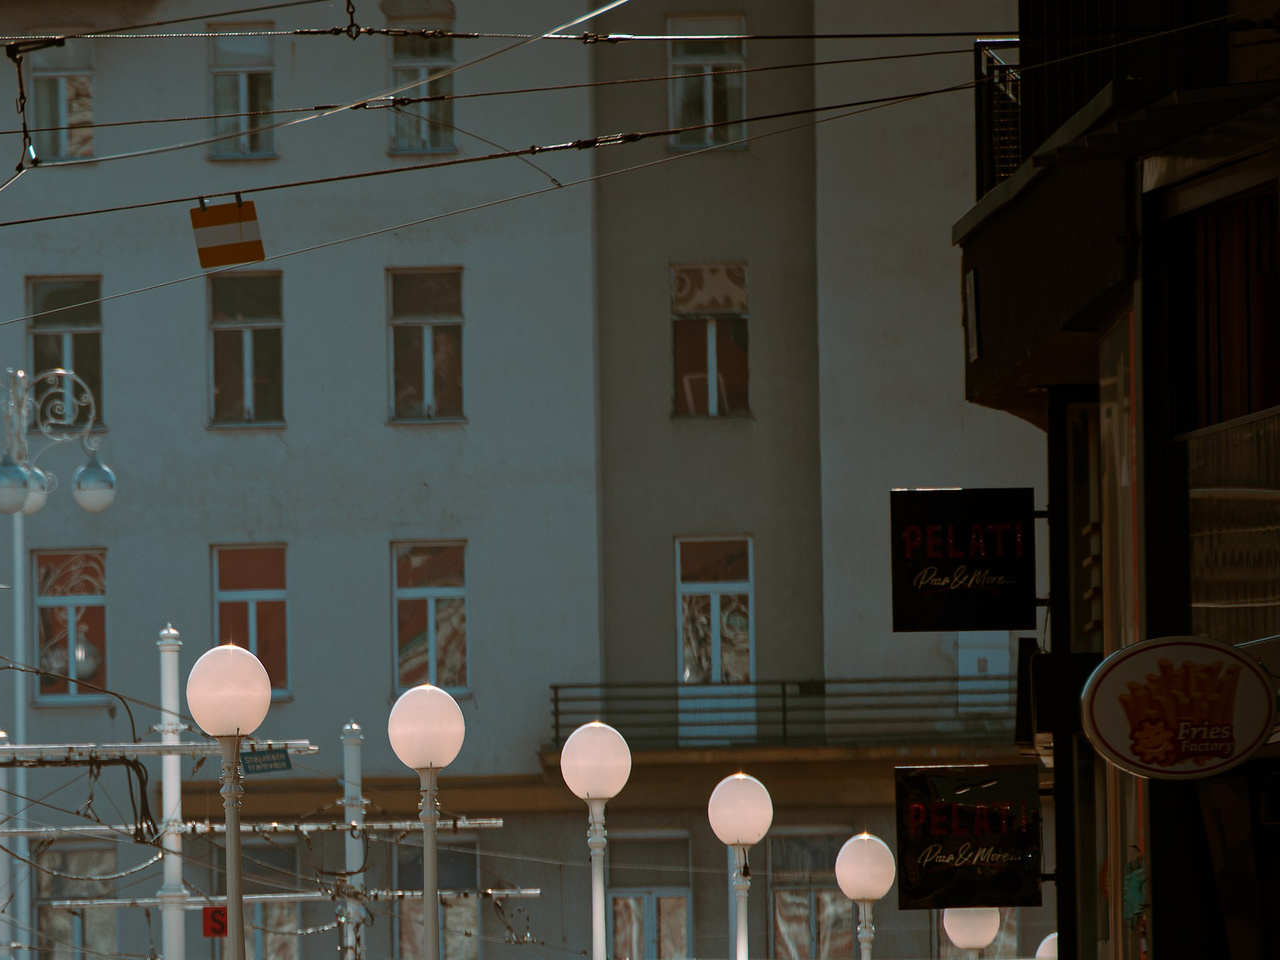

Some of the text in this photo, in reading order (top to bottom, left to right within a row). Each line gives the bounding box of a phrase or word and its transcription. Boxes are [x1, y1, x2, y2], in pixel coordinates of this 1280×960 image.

[903, 523, 1024, 559] PELATI
[950, 565, 969, 590] &
[1178, 720, 1233, 740] Fries
[1180, 740, 1236, 754] Factory
[908, 800, 1028, 837] PELATI
[954, 842, 974, 867] &
[211, 910, 225, 935] S
